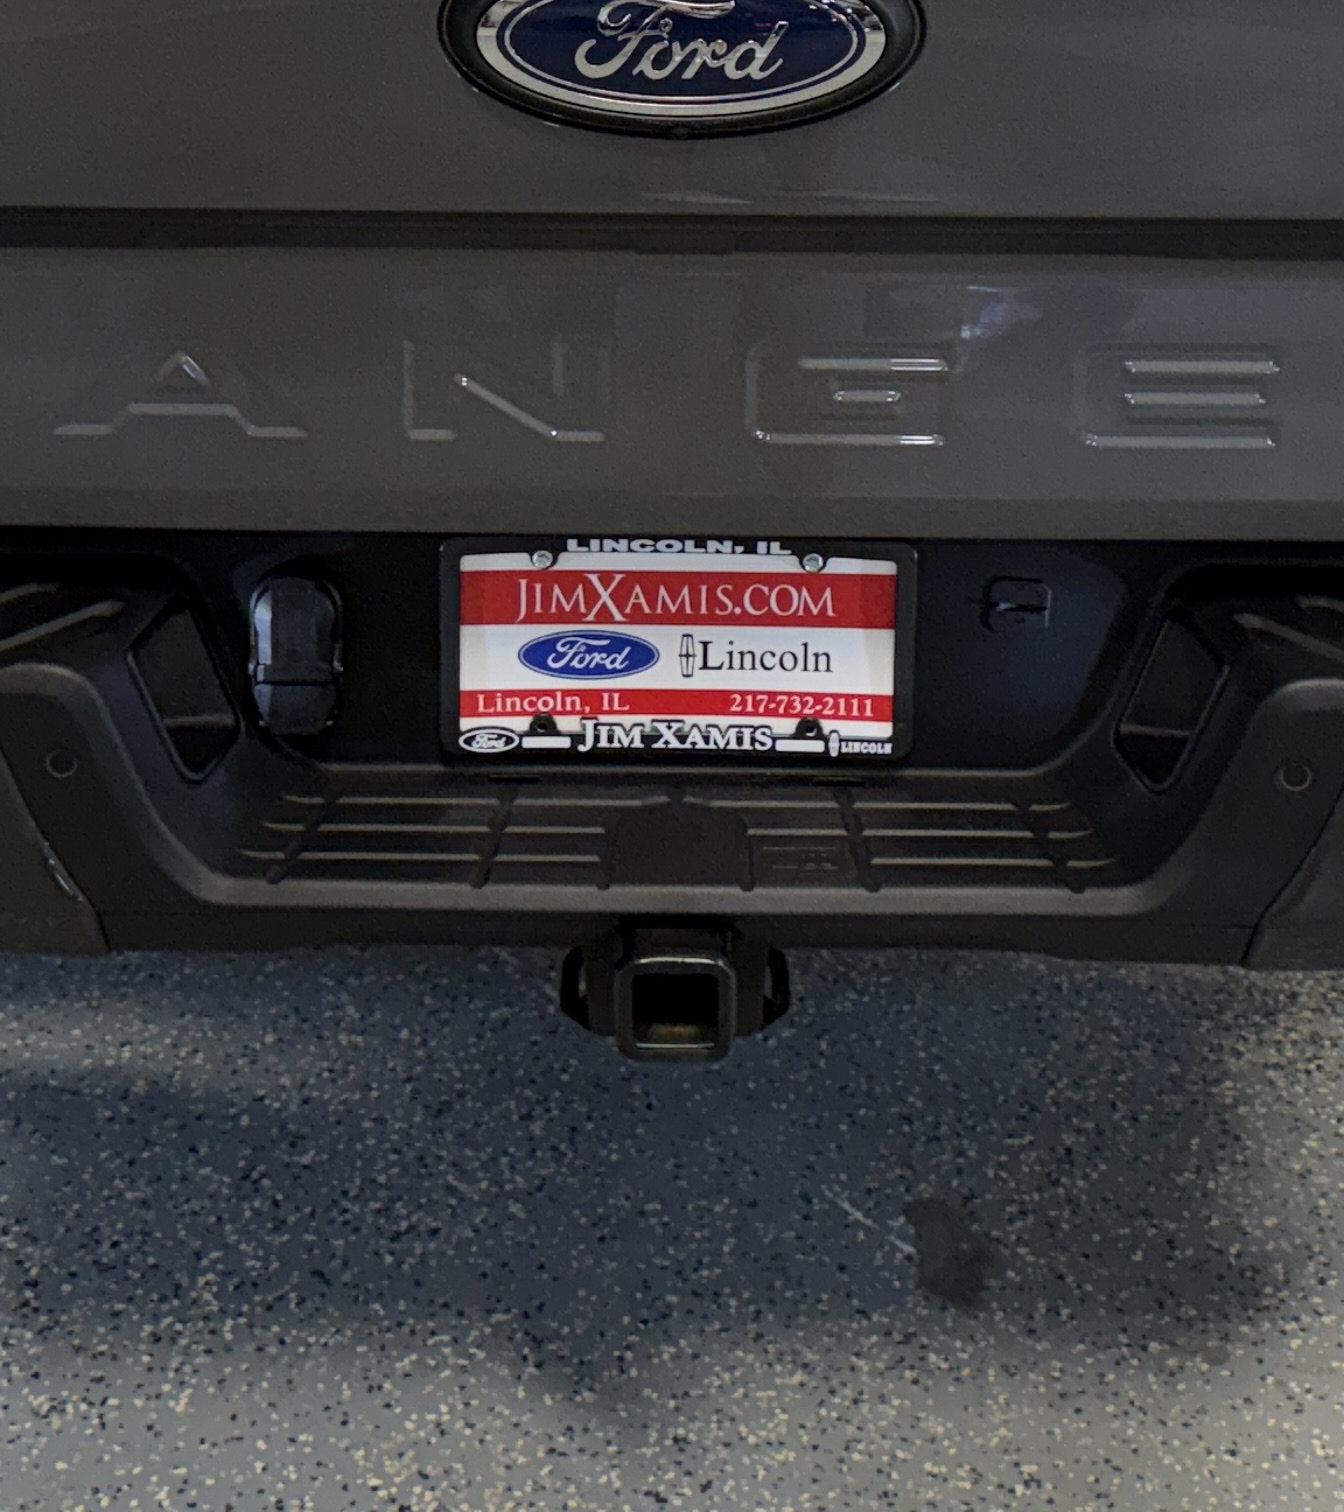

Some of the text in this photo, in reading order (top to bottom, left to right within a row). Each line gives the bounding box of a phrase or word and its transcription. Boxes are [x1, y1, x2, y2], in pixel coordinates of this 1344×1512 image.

[566, 538, 793, 556] LINCOLN, IL
[546, 638, 631, 671] Ford
[698, 640, 833, 673] Lincoln
[476, 692, 631, 717] Lincoln, IL
[729, 694, 875, 718] 217-732-2111
[471, 733, 506, 750] Ford
[578, 718, 774, 752] JIM XAMIS
[840, 740, 892, 755] LINCOLN
